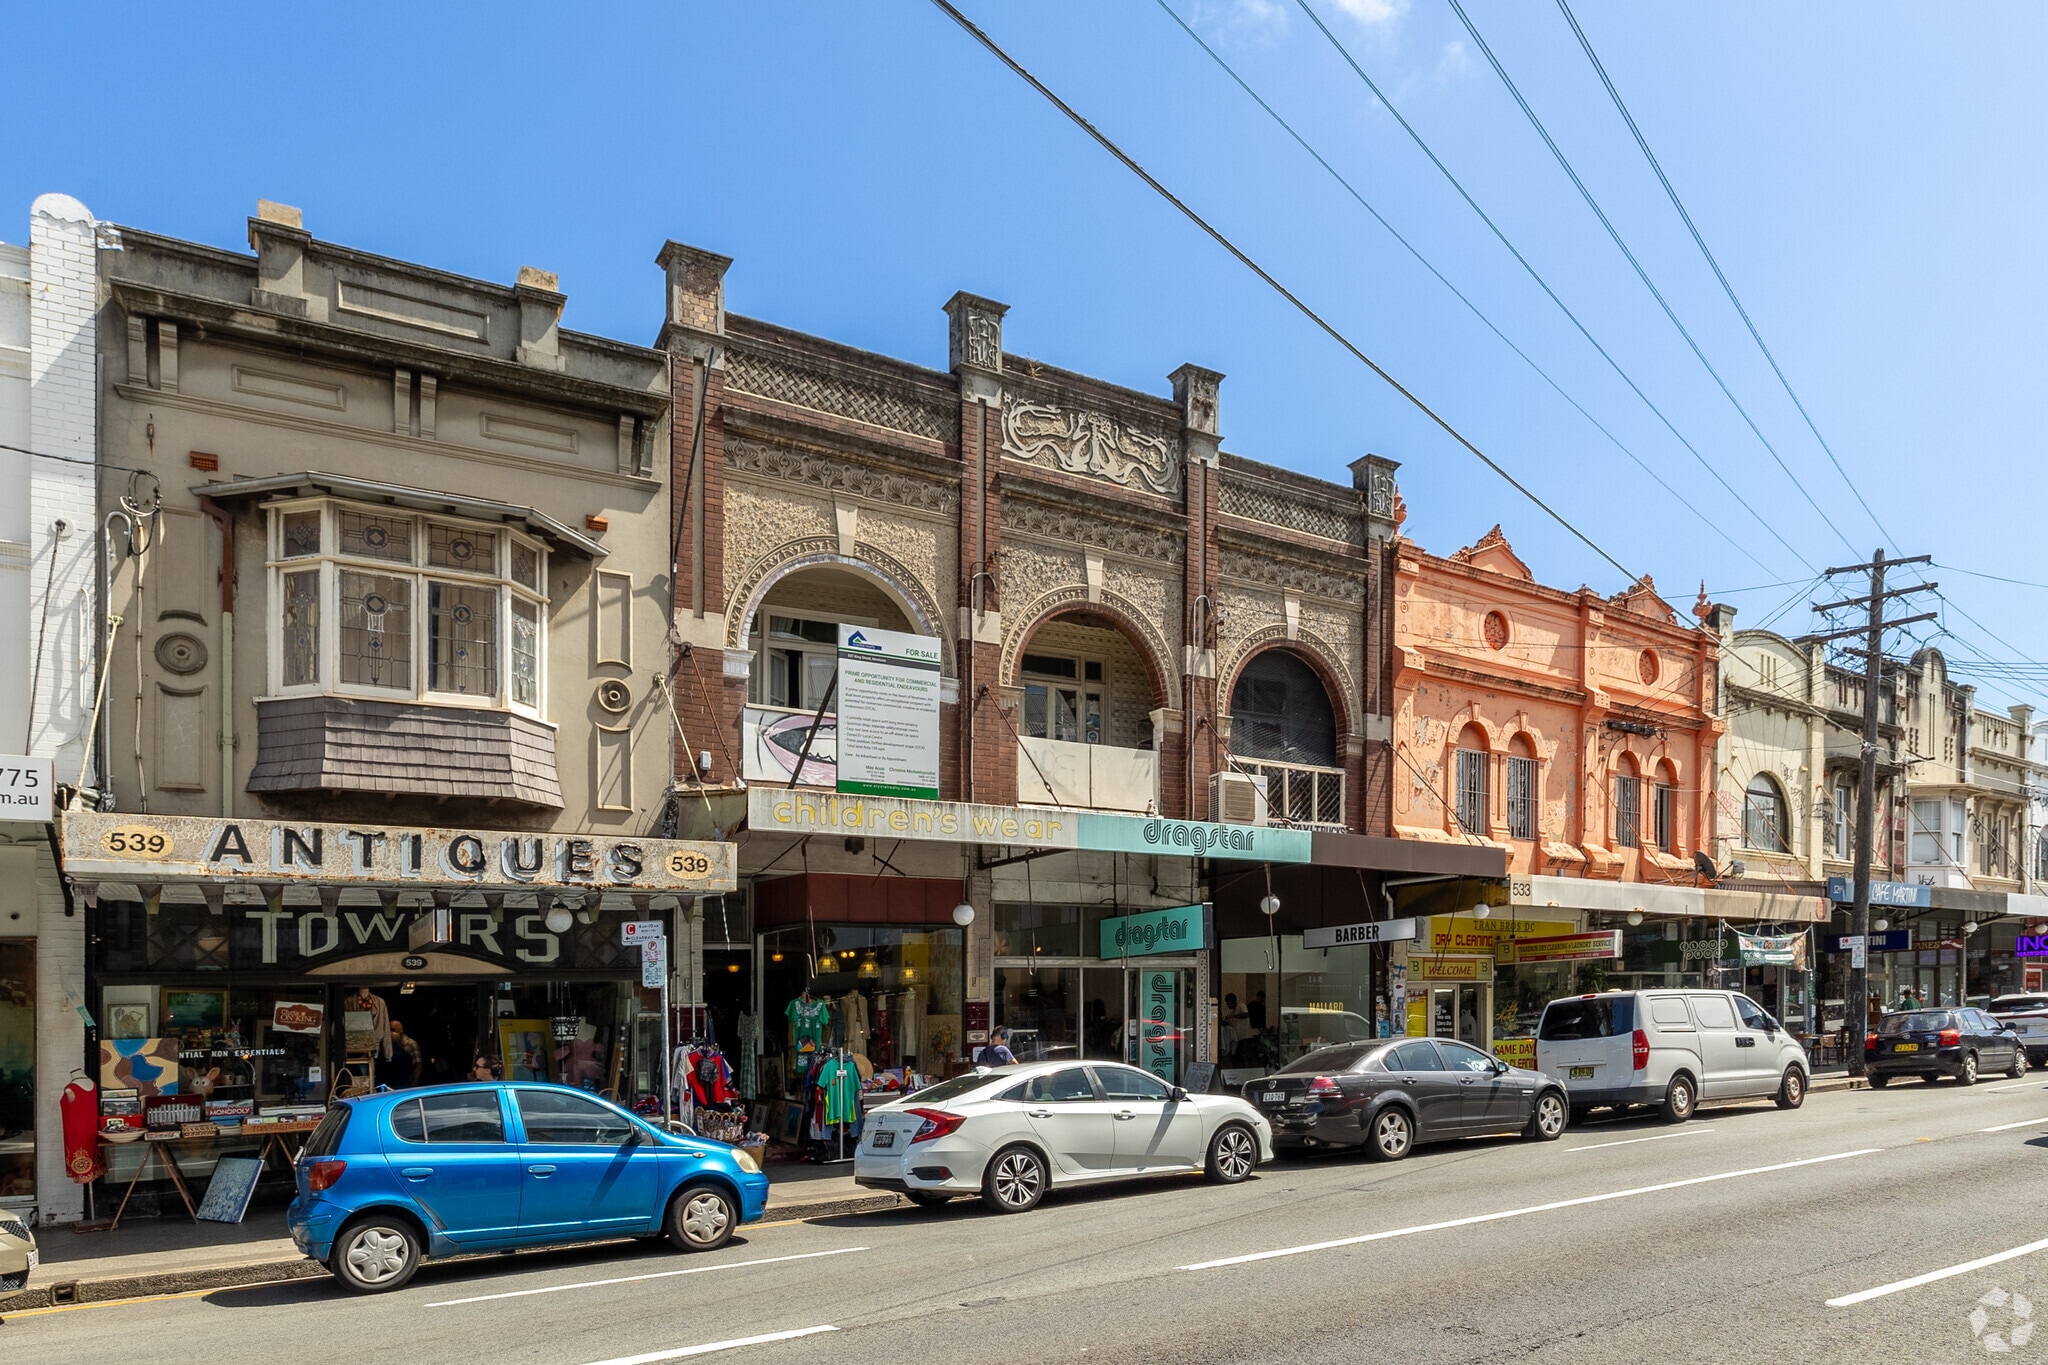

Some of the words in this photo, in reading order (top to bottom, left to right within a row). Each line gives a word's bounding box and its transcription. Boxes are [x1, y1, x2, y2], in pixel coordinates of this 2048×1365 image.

[906, 649, 919, 657] FOR
[921, 651, 938, 659] SALE
[861, 672, 895, 681] OPPORTUNITY
[906, 678, 937, 687] COMMERCIAL
[866, 679, 896, 688] RESIDENTIAL
[897, 683, 928, 692] ENDEAVOURS
[0, 769, 38, 788] 75
[773, 795, 958, 834] children's
[972, 816, 1062, 839] wear
[109, 832, 166, 853] 539
[1143, 818, 1254, 856] dragstar
[208, 825, 642, 882] ANTIQUES
[671, 856, 708, 873] 539
[1512, 882, 1531, 897] 533
[1473, 920, 1496, 931] TRAN
[1500, 921, 1521, 931] BROS
[1525, 922, 1535, 931] DC
[246, 911, 560, 963] TOWRS
[1114, 915, 1188, 951] dragstar
[1335, 925, 1380, 943] BARBER
[1435, 933, 1452, 946] DRY
[1455, 934, 1493, 946] CLEANING
[1868, 934, 1887, 945] TINI
[1593, 939, 1611, 948] SERVICE
[1680, 939, 1728, 951] FLOUR
[405, 959, 423, 967] 539
[1429, 965, 1472, 975] WELCOME
[1309, 1002, 1344, 1014] MALLARD
[1144, 974, 1173, 1080] dragst
[235, 1049, 286, 1057] ESSENTIALS
[1495, 1044, 1516, 1055] SAME
[1519, 1044, 1535, 1055] DAY
[209, 1108, 250, 1116] MONOPOLY
